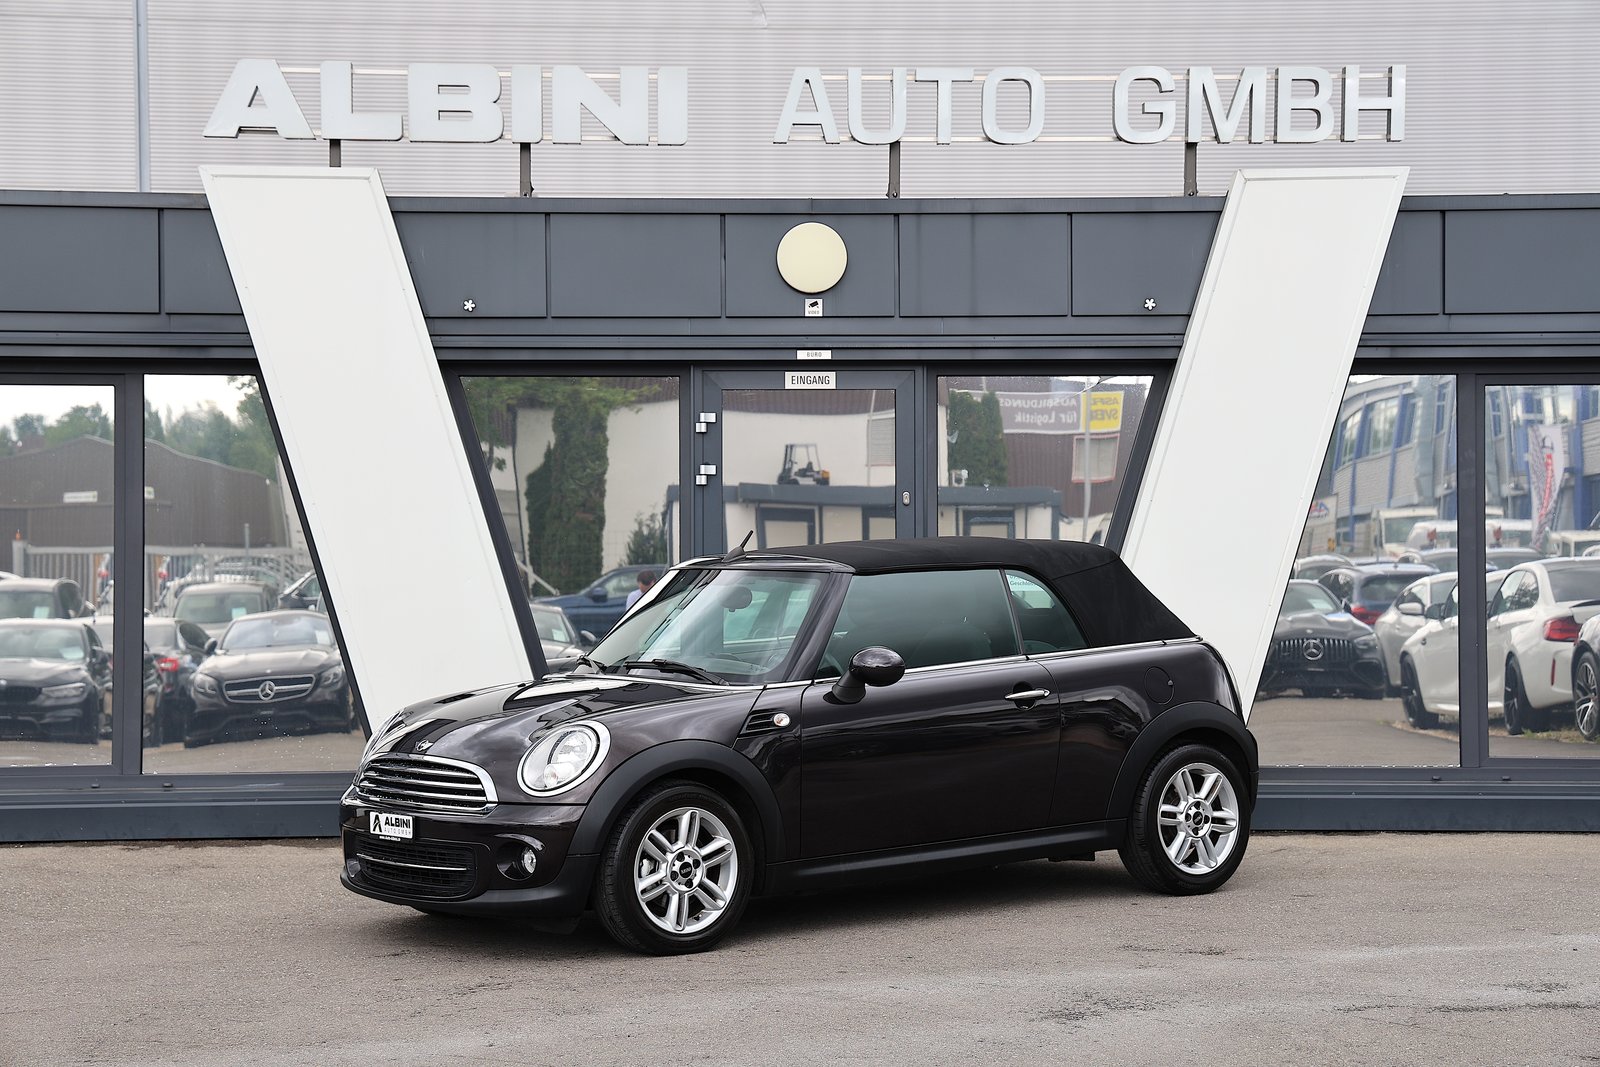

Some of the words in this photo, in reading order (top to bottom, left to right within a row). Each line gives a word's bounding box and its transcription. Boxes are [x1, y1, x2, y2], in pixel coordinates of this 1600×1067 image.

[202, 58, 688, 146] ALBINI
[773, 66, 1046, 146] AUTO
[1112, 64, 1407, 145] GMBH
[791, 375, 831, 385] EINGANG
[385, 816, 411, 829] ALBINI
